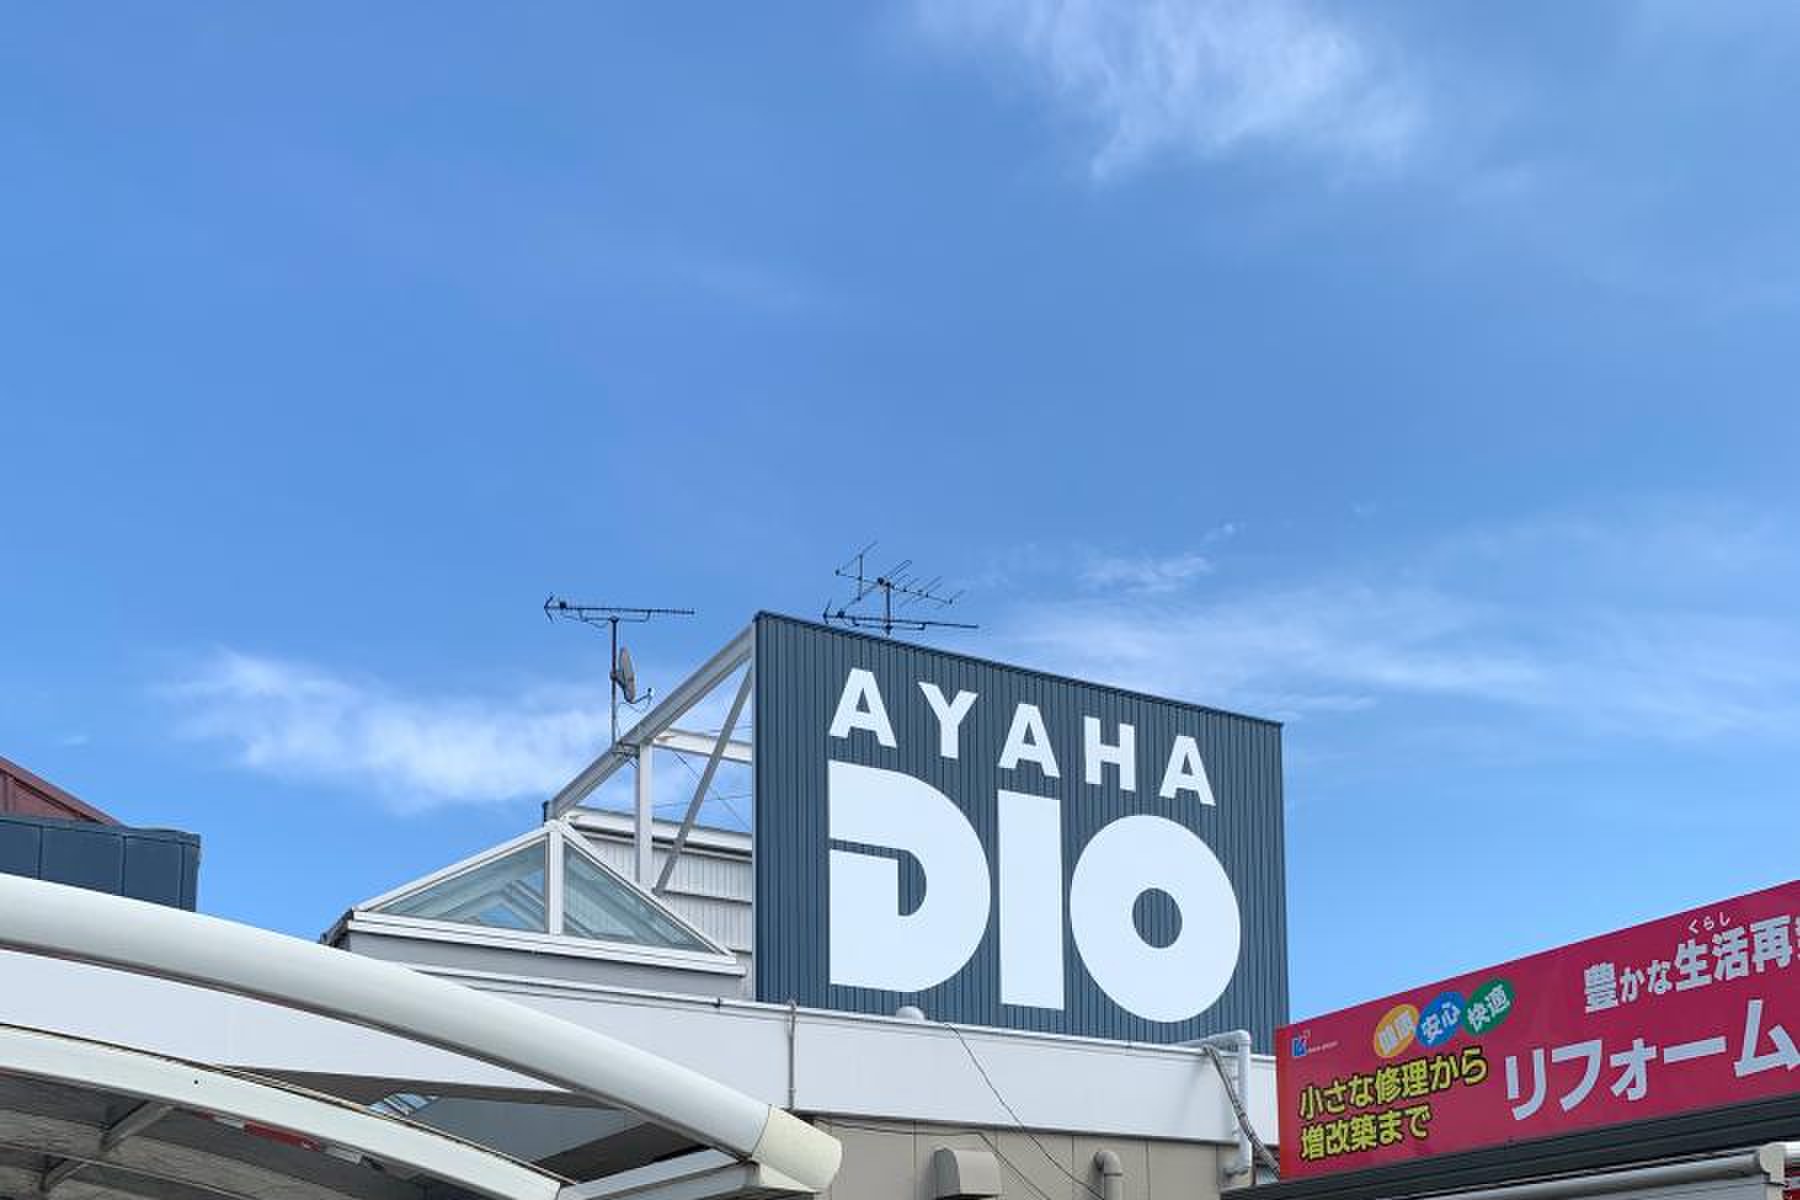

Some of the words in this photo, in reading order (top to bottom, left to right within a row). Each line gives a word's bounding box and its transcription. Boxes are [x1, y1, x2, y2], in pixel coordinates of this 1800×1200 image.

[829, 667, 1216, 806] AYAHA
[828, 759, 1241, 1023] DIO
[1688, 911, 1731, 935] くらし
[1583, 914, 1800, 1014] 豊かな生活再
[1420, 1001, 1462, 1044] 安心
[1505, 998, 1800, 1121] リフォーム
[1299, 1047, 1488, 1121] 小さな修理から
[1300, 1104, 1432, 1161] 増改築まで
